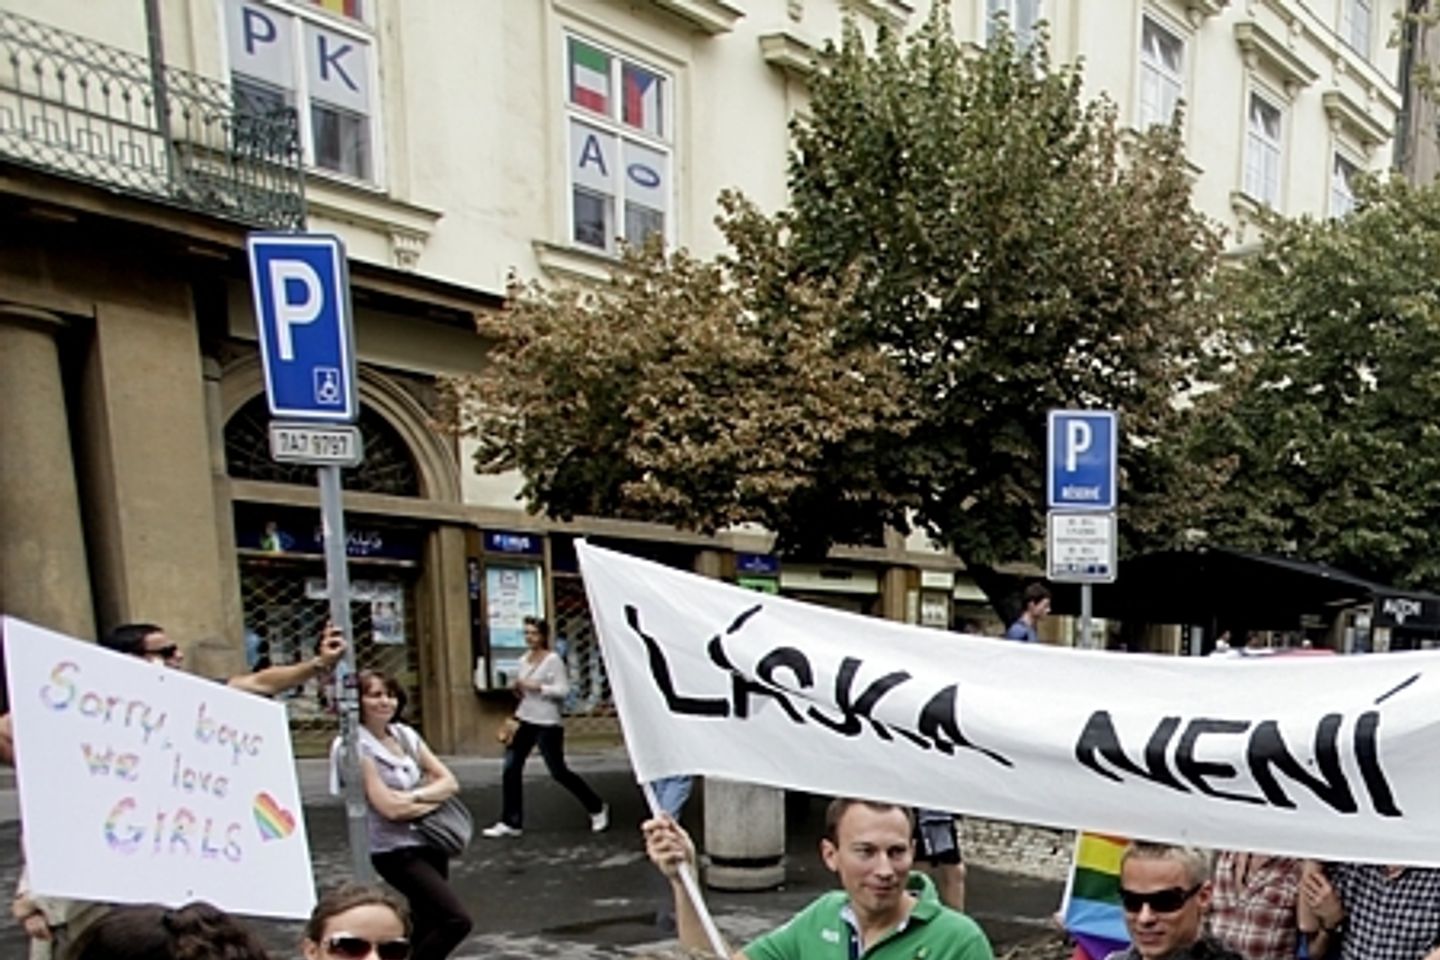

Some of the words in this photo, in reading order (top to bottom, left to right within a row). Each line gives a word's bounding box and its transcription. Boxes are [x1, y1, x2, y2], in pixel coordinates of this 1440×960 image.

[270, 260, 322, 360] P
[1066, 419, 1093, 472] P
[39, 661, 173, 749] Sorry,
[623, 603, 1014, 768] LÁSKA
[1074, 673, 1422, 817] NENÍ
[171, 753, 229, 798] love
[104, 796, 244, 862] GIRLS
